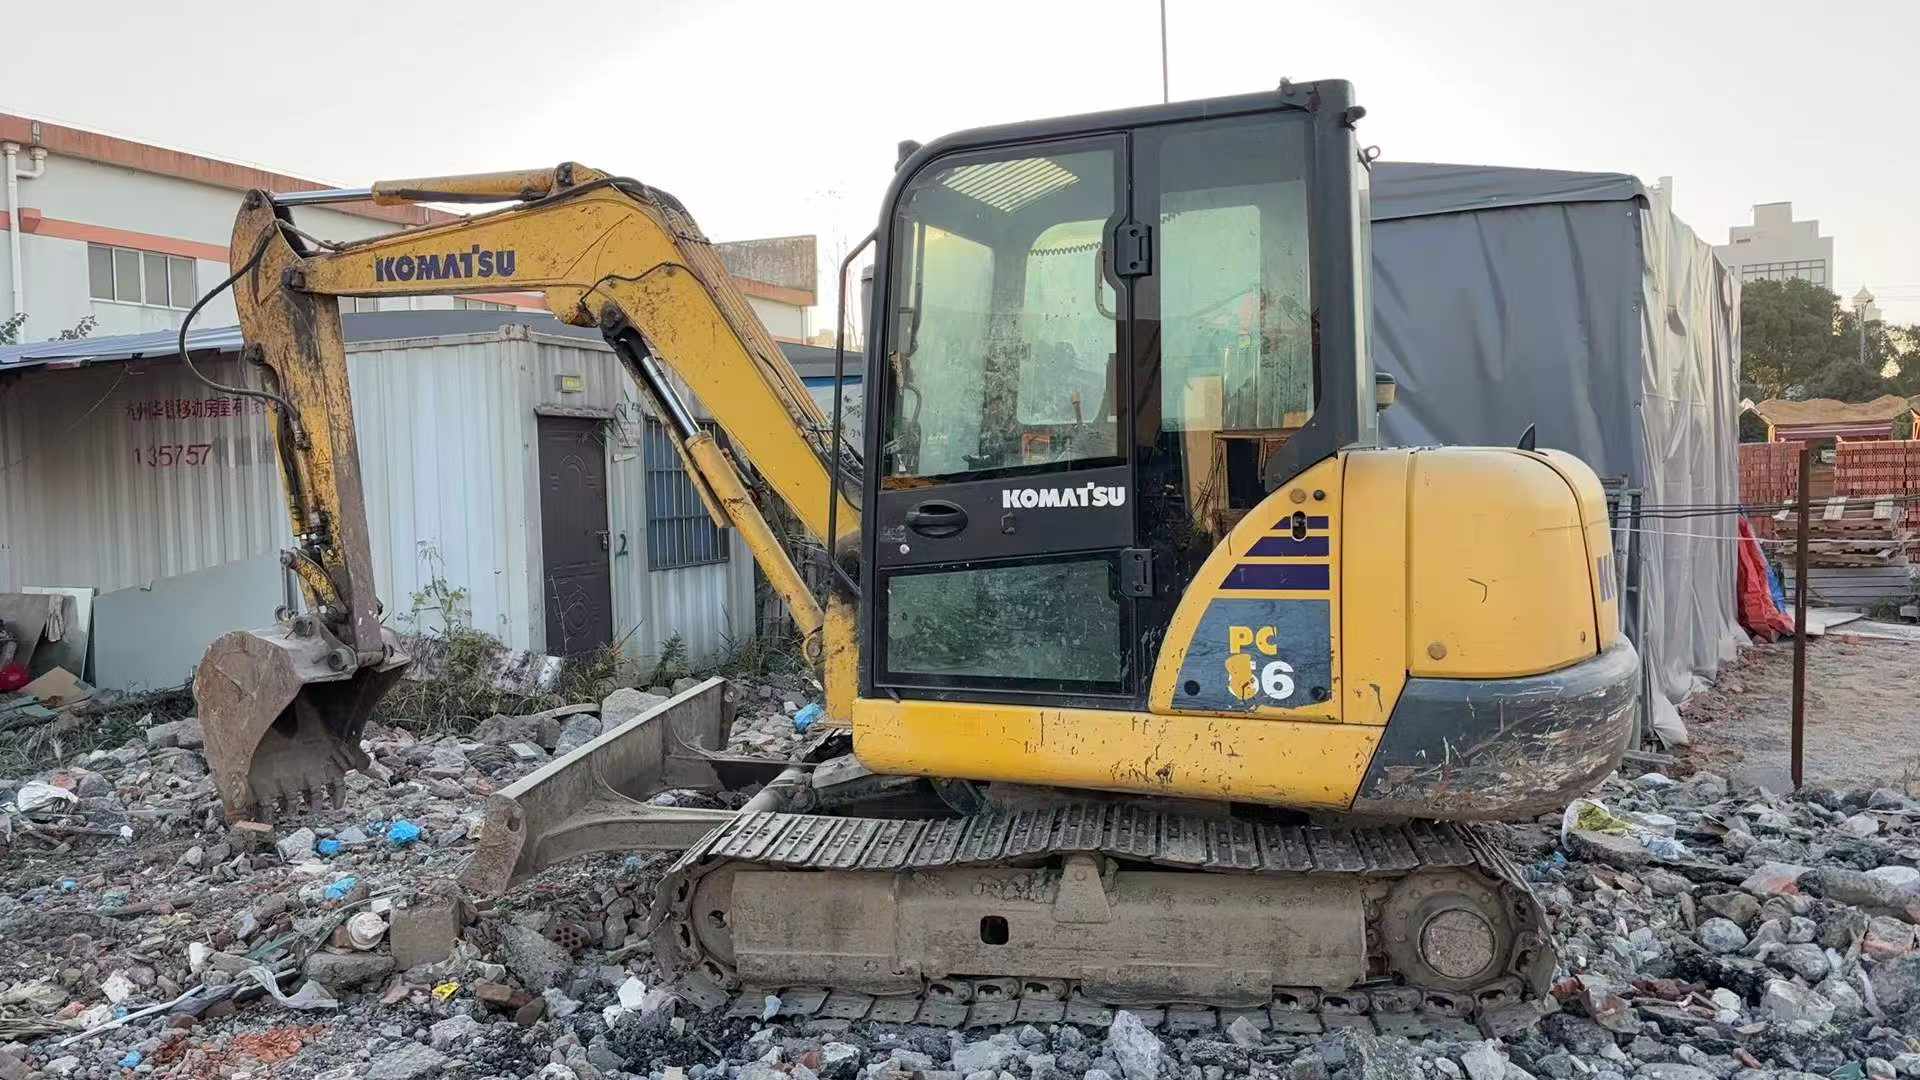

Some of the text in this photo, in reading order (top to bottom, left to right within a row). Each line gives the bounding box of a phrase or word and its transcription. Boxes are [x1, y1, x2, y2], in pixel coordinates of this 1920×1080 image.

[375, 244, 516, 281] KOMATSU
[1002, 482, 1126, 508] KOMATSU
[1229, 626, 1278, 655] PC
